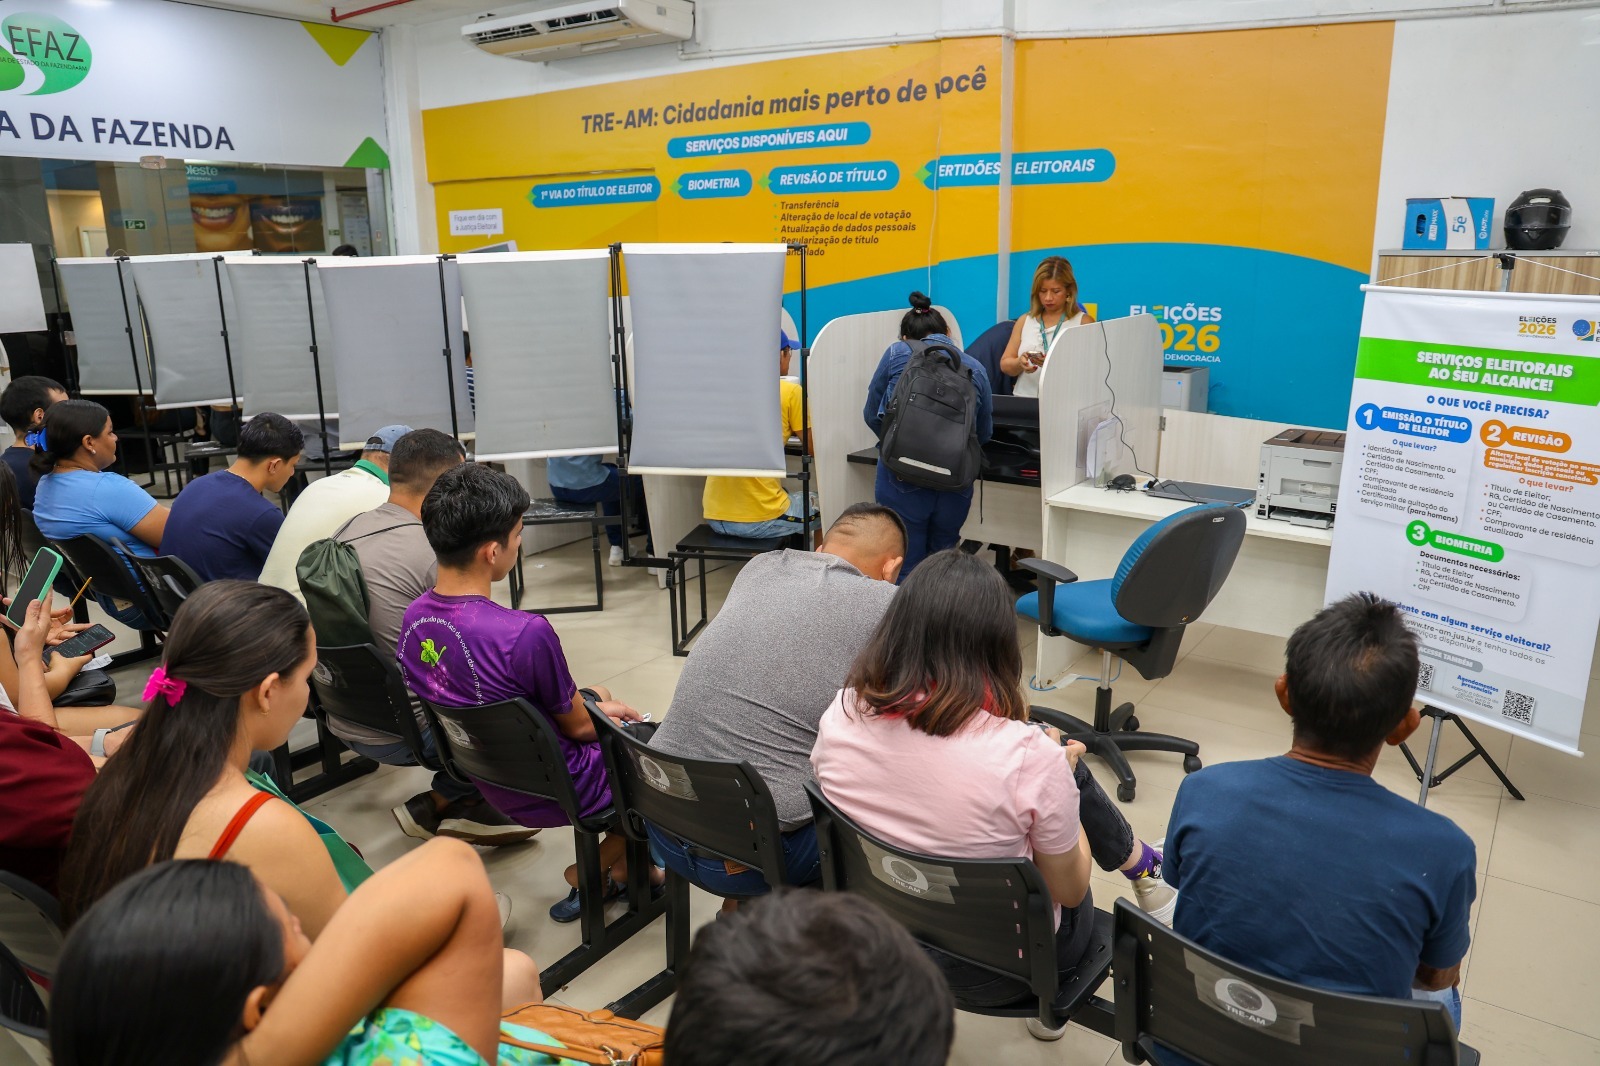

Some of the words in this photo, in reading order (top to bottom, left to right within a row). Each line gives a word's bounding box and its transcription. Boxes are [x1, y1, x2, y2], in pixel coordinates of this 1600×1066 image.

[582, 108, 659, 134] TRE-AM:
[663, 95, 765, 125] Cidadania
[768, 88, 821, 114] mais
[825, 85, 890, 114] perto
[897, 79, 927, 102] de
[30, 112, 82, 142] DA
[92, 118, 235, 151] FAZENDA
[686, 136, 740, 154] SERVIÇOS
[741, 129, 815, 149] DISPONÍVEIS
[816, 128, 848, 143] AQUI
[780, 170, 827, 186] REVISÃO
[829, 171, 843, 183] DE
[846, 168, 887, 182] TÍTULO
[938, 160, 1002, 177] ERTIDÕES
[1014, 159, 1096, 175] ELEITORAIS
[549, 190, 562, 199] VIA
[564, 189, 575, 199] DO
[577, 185, 605, 197] TÍTULO
[606, 186, 617, 196] DE
[618, 183, 652, 195] ELEITOR
[688, 178, 740, 190] BIOMETRIA
[781, 200, 840, 210] Transferência
[781, 213, 821, 223] Alteração
[824, 212, 834, 220] de
[837, 211, 858, 220] local
[860, 211, 871, 219] de
[874, 210, 911, 221] votação
[1452, 216, 1467, 233] 5e
[781, 224, 830, 235] Atualização
[833, 224, 843, 232] de
[846, 224, 873, 232] dados
[875, 222, 916, 233] pessoais
[781, 236, 840, 246] Regularização
[842, 236, 852, 244] de
[855, 235, 879, 244] título
[1519, 316, 1557, 324] ELEIÇÕES
[1519, 323, 1556, 335] 2026
[1165, 354, 1221, 363] DEMOCRACIA
[1417, 351, 1483, 370] SERVIÇOS
[1486, 358, 1574, 378] ELEITORAIS
[1428, 367, 1450, 380] AO
[1452, 369, 1479, 384] SEU
[1481, 373, 1554, 392] ALCANCE!
[1427, 396, 1435, 404] O
[1438, 397, 1460, 407] QUE
[1463, 400, 1492, 412] VOCÊ
[1495, 404, 1550, 419] PRECISA?
[1363, 409, 1373, 425] 1
[1382, 411, 1422, 424] EMISSÃO
[1425, 417, 1432, 425] O
[1435, 417, 1468, 430] TÍTULO
[1398, 422, 1410, 431] DE
[1412, 425, 1450, 437] ELEITOR
[1487, 425, 1502, 441] 2
[1399, 440, 1412, 449] que
[1414, 442, 1437, 452] levar?
[1513, 431, 1564, 447] REVISÃO
[1366, 460, 1394, 470] Certidão
[1395, 464, 1404, 472] de
[1405, 466, 1445, 480] Casamento.
[1367, 452, 1395, 463] Certidão
[1396, 456, 1405, 464] de
[1406, 457, 1446, 471] Nascimento
[1364, 475, 1408, 489] Comprovante
[1409, 481, 1418, 490] de
[1419, 484, 1454, 498] residência
[1491, 484, 1511, 493] Título
[1513, 487, 1523, 495] de
[1545, 481, 1574, 492] levar?
[1362, 490, 1397, 502] Certificado
[1398, 495, 1406, 503] de
[1408, 497, 1438, 512] quitação
[1439, 502, 1448, 512] do
[1503, 495, 1536, 507] Certidão
[1538, 501, 1548, 509] de
[1551, 504, 1600, 519] Nascimento
[1361, 498, 1384, 508] serviço
[1384, 501, 1406, 512] militar
[1407, 506, 1426, 516] (para
[1427, 508, 1459, 524] homens)
[1499, 503, 1532, 514] Certidão
[1534, 509, 1544, 517] de
[1546, 512, 1596, 528] Casamento.
[1412, 525, 1425, 541] 3
[1484, 525, 1524, 538] atualizado
[1485, 517, 1537, 533] Comprovante
[1539, 527, 1550, 535] de
[1551, 531, 1594, 545] residência
[1435, 535, 1493, 556] BIOMETRIA
[1420, 551, 1468, 568] Documentos
[1469, 564, 1520, 581] necessários:
[1422, 561, 1440, 571] Título
[1442, 566, 1451, 574] de
[1452, 569, 1474, 579] Eleitor
[1418, 584, 1430, 592] CPF
[1430, 579, 1459, 592] Certidão
[1461, 587, 1470, 595] de
[1471, 590, 1516, 607] Casamento.
[1433, 570, 1463, 584] Certidão
[1465, 579, 1473, 588] de
[1475, 582, 1520, 599] Nascimento
[1422, 610, 1439, 620] com
[1441, 616, 1468, 629] algum
[1471, 624, 1502, 639] serviço
[1505, 634, 1551, 652] eleitoral?
[455, 632, 461, 640] de
[460, 639, 470, 658] vocês
[1484, 641, 1507, 654] tenha
[1510, 649, 1533, 661] todos
[892, 877, 920, 894] TRE-AM
[1226, 1005, 1266, 1025] TRE-AM
